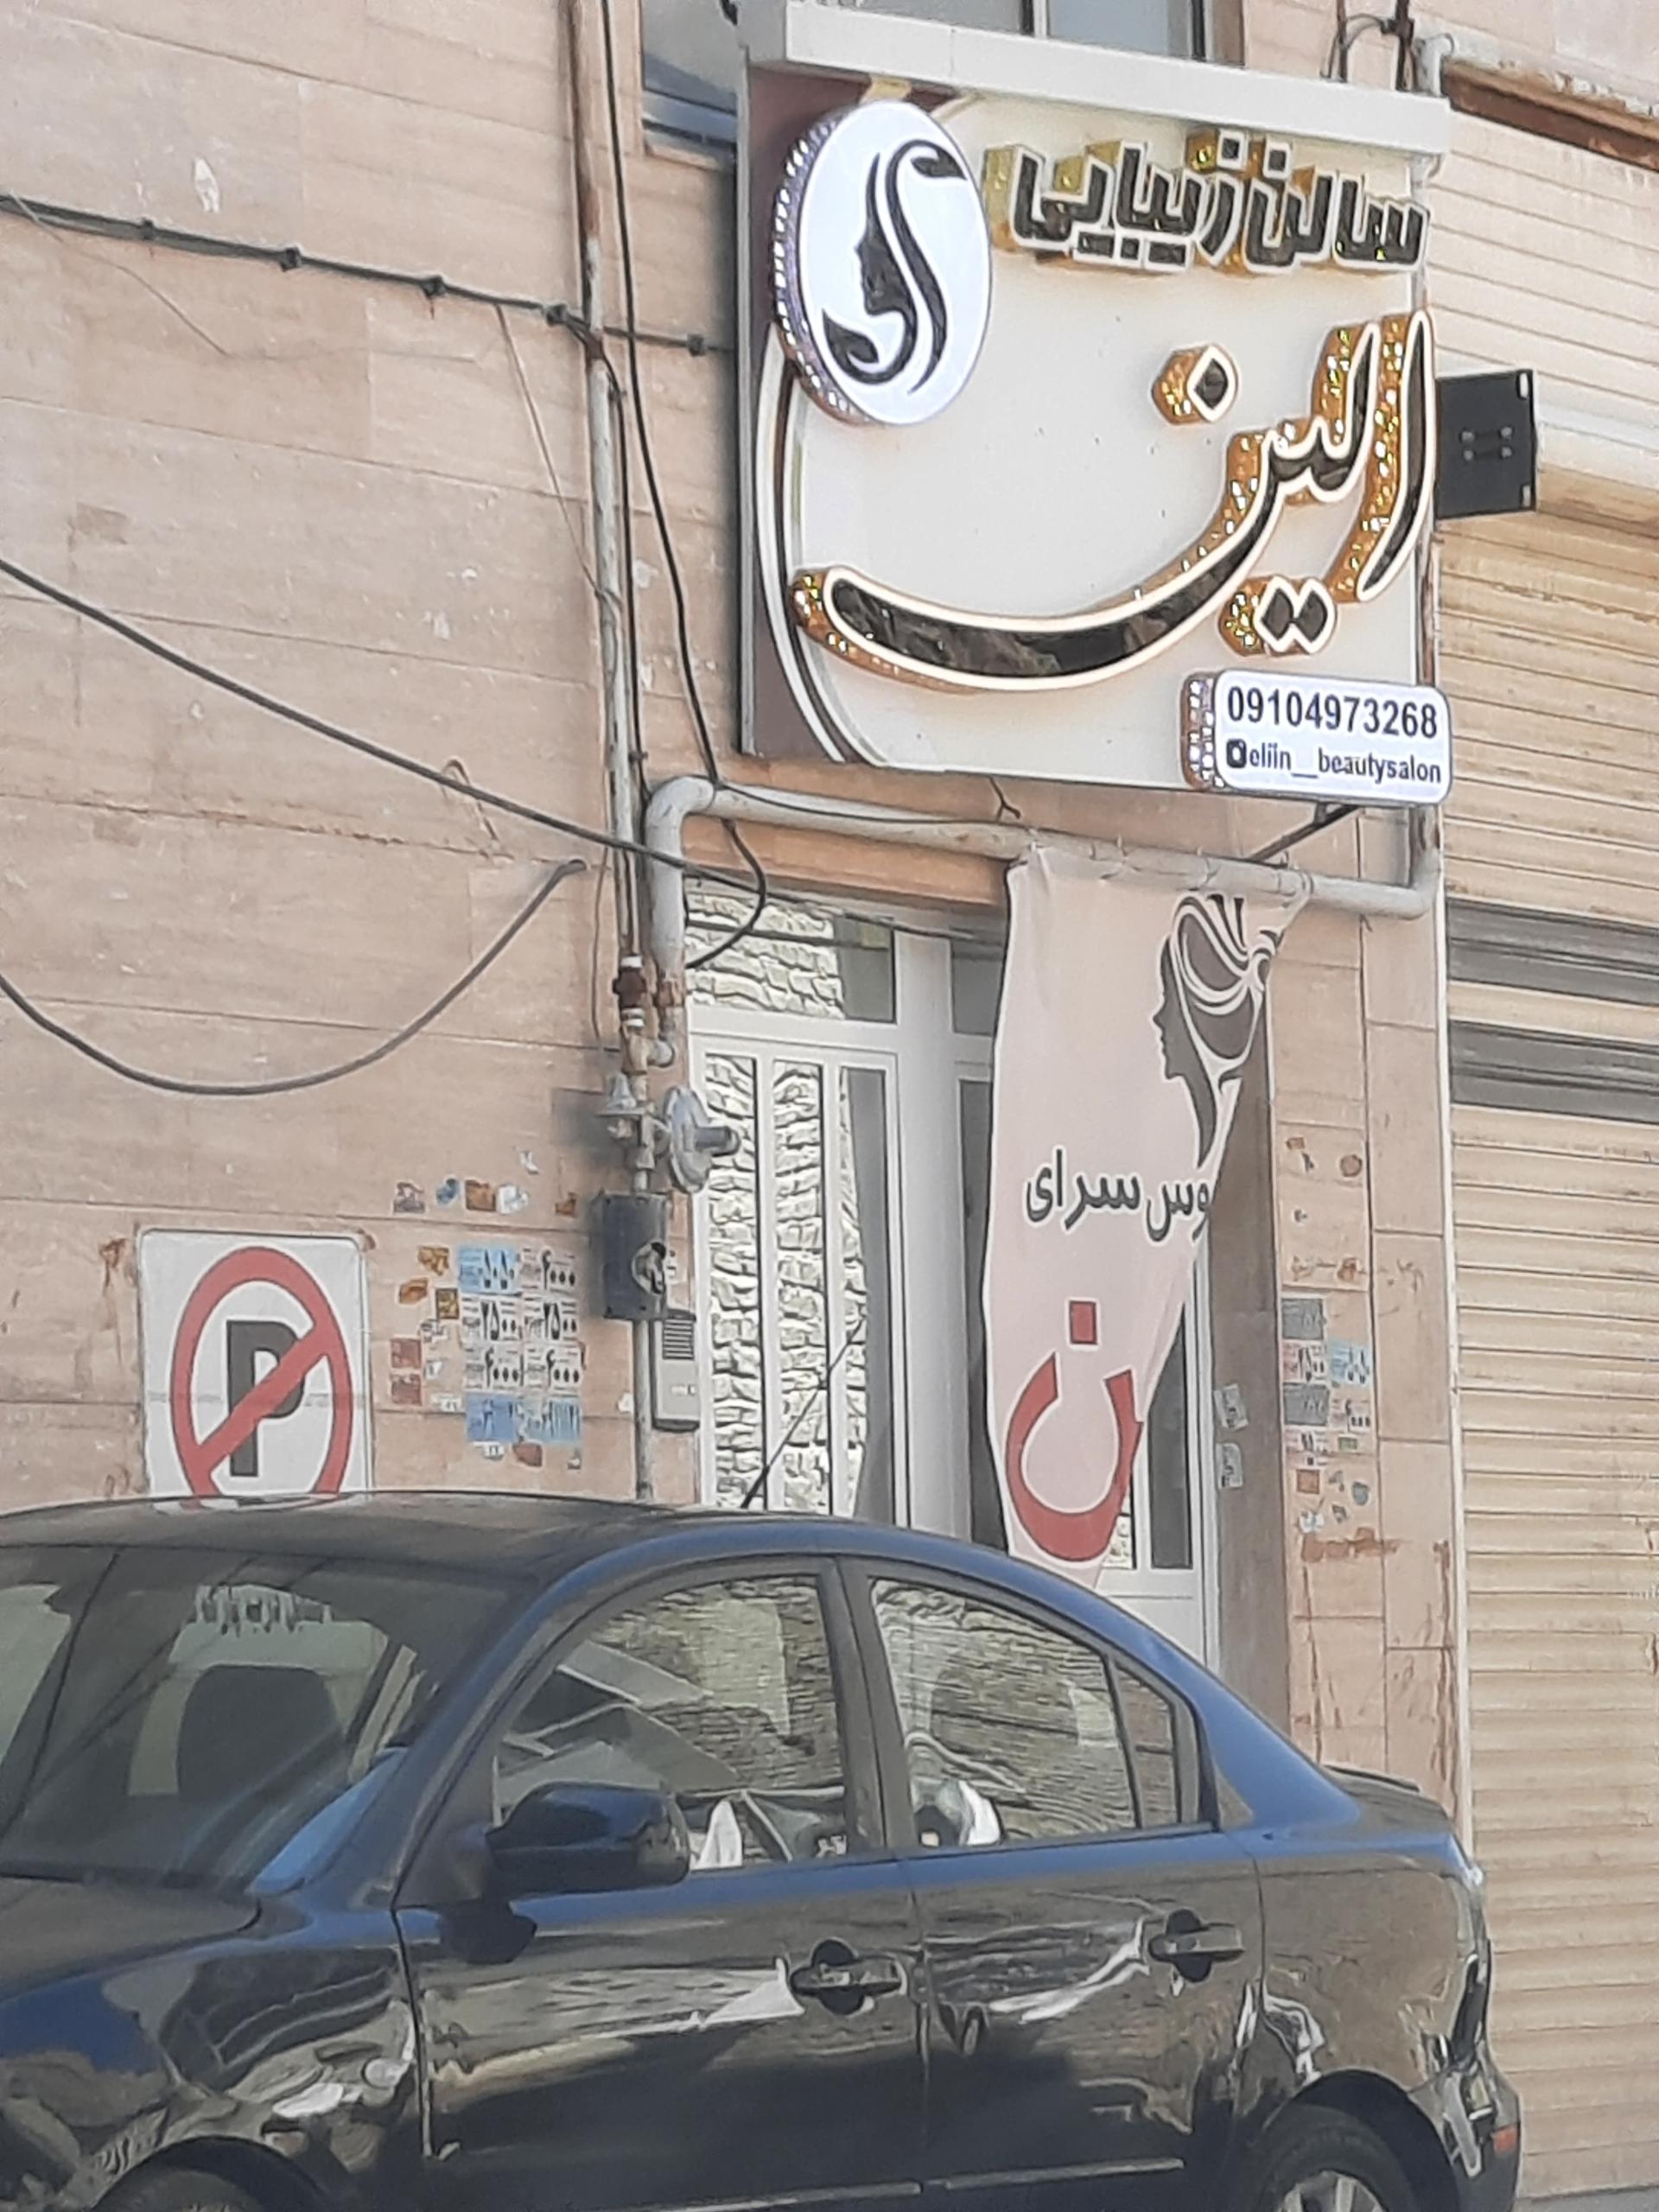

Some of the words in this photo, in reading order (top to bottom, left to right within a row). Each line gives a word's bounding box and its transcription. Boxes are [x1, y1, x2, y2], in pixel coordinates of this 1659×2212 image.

[1244, 138, 1430, 272] سالن
[1227, 686, 1438, 739] 09104973268
[1026, 1147, 1141, 1230] سرای
